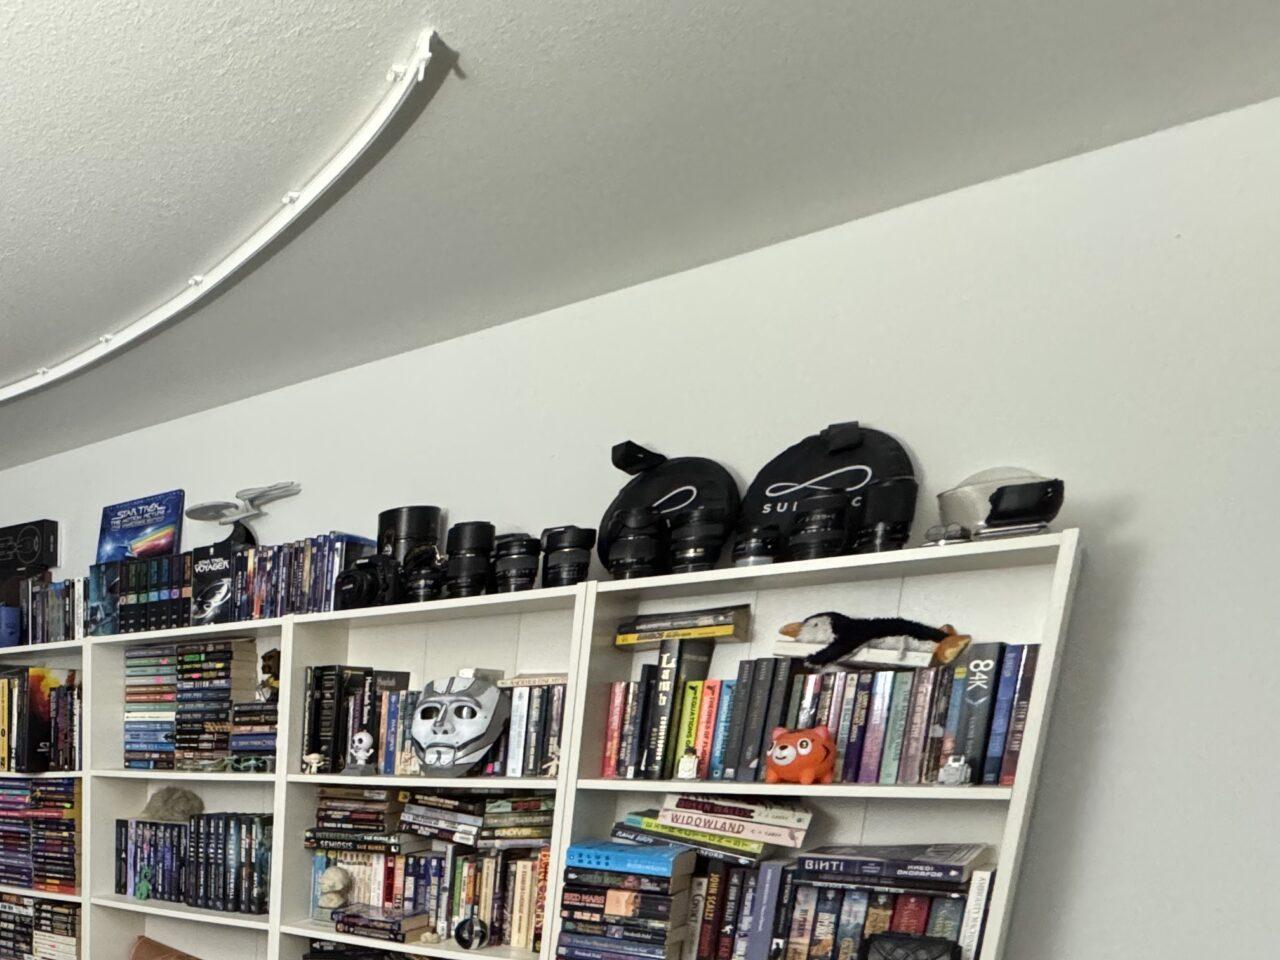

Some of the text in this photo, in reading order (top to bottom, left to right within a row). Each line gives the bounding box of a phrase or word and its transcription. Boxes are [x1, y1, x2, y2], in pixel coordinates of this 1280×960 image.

[195, 561, 230, 573] VOYAGER
[967, 659, 994, 691] 84K
[686, 695, 698, 739] EQUATIONS
[704, 695, 715, 729] THEORIES
[719, 694, 729, 721] SIMON
[671, 812, 745, 835] WIDOWLAND
[319, 840, 353, 850] SEMIOSIS
[896, 869, 944, 878] OKORAFOR
[582, 894, 605, 903] MARS
[703, 872, 719, 921] JOHN SCALZI
[727, 885, 737, 900] JOHN
[724, 900, 735, 922] SCALZI
